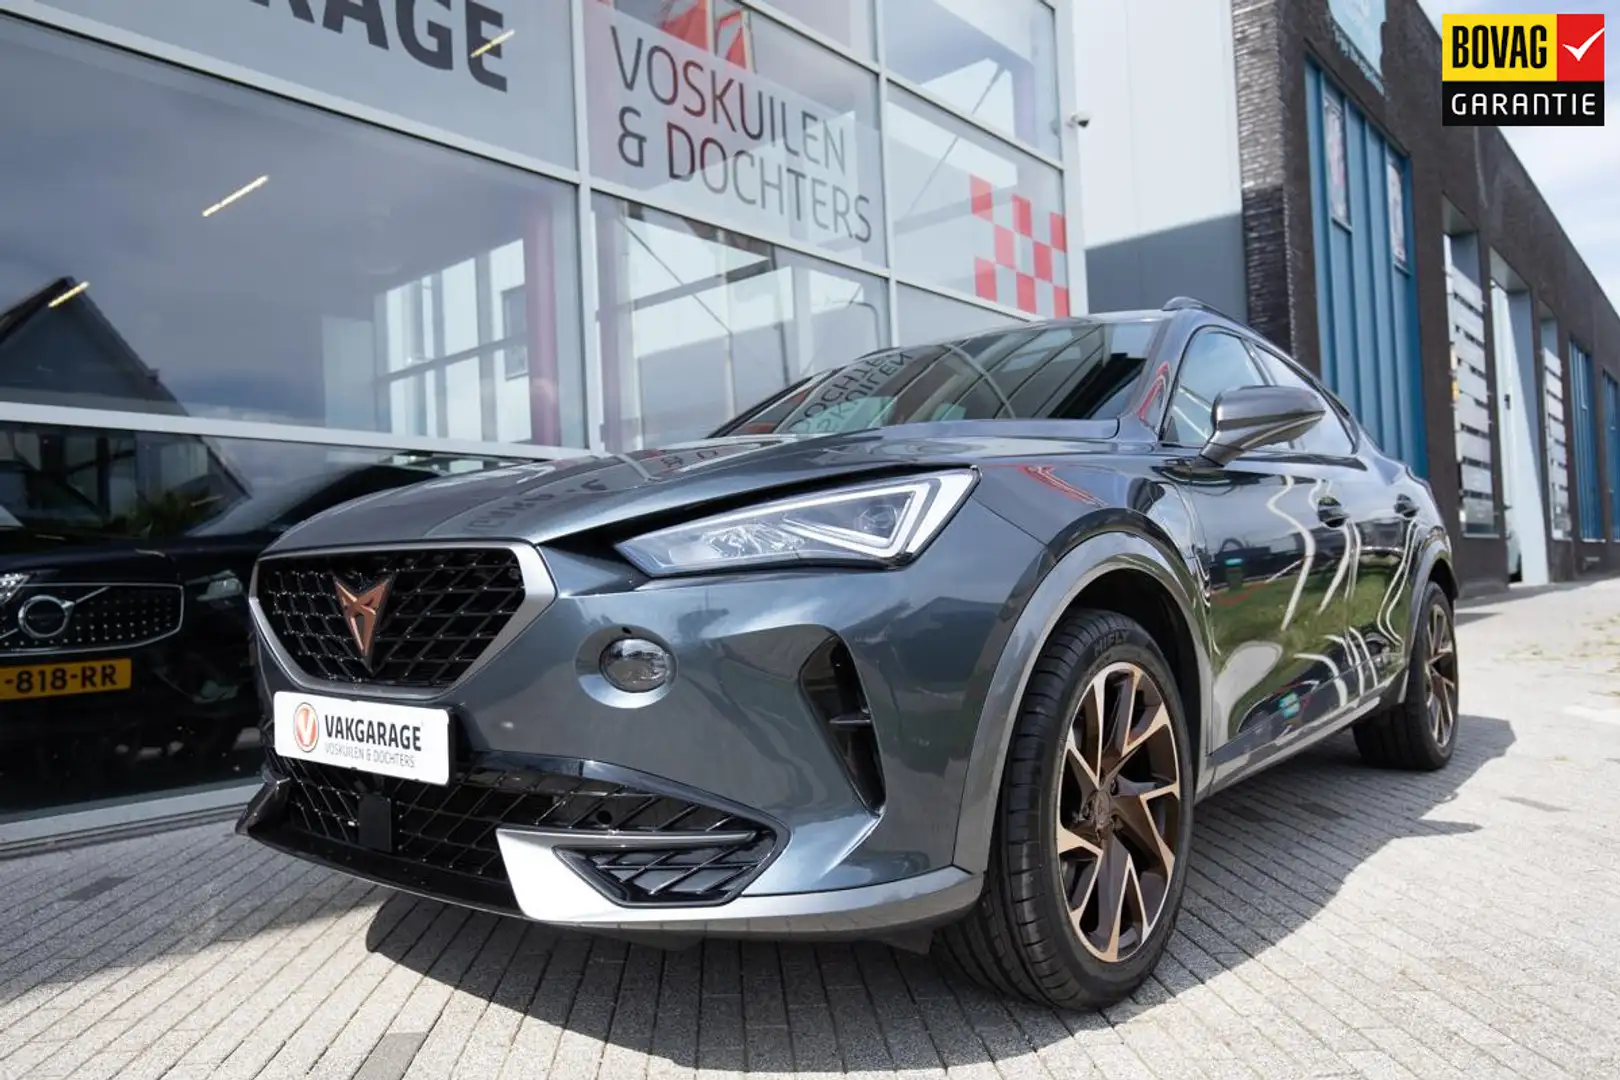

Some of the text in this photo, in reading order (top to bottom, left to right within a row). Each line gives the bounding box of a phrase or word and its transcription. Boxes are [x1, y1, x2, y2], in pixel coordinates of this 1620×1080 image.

[249, 0, 508, 93] AGE
[610, 25, 846, 175] VOSKUILEN
[618, 105, 873, 243] & DOCHTERS
[324, 741, 365, 760] VOSKUILEN
[373, 750, 416, 768] DOCHTERS
[325, 714, 422, 751] VAKGARAGE
